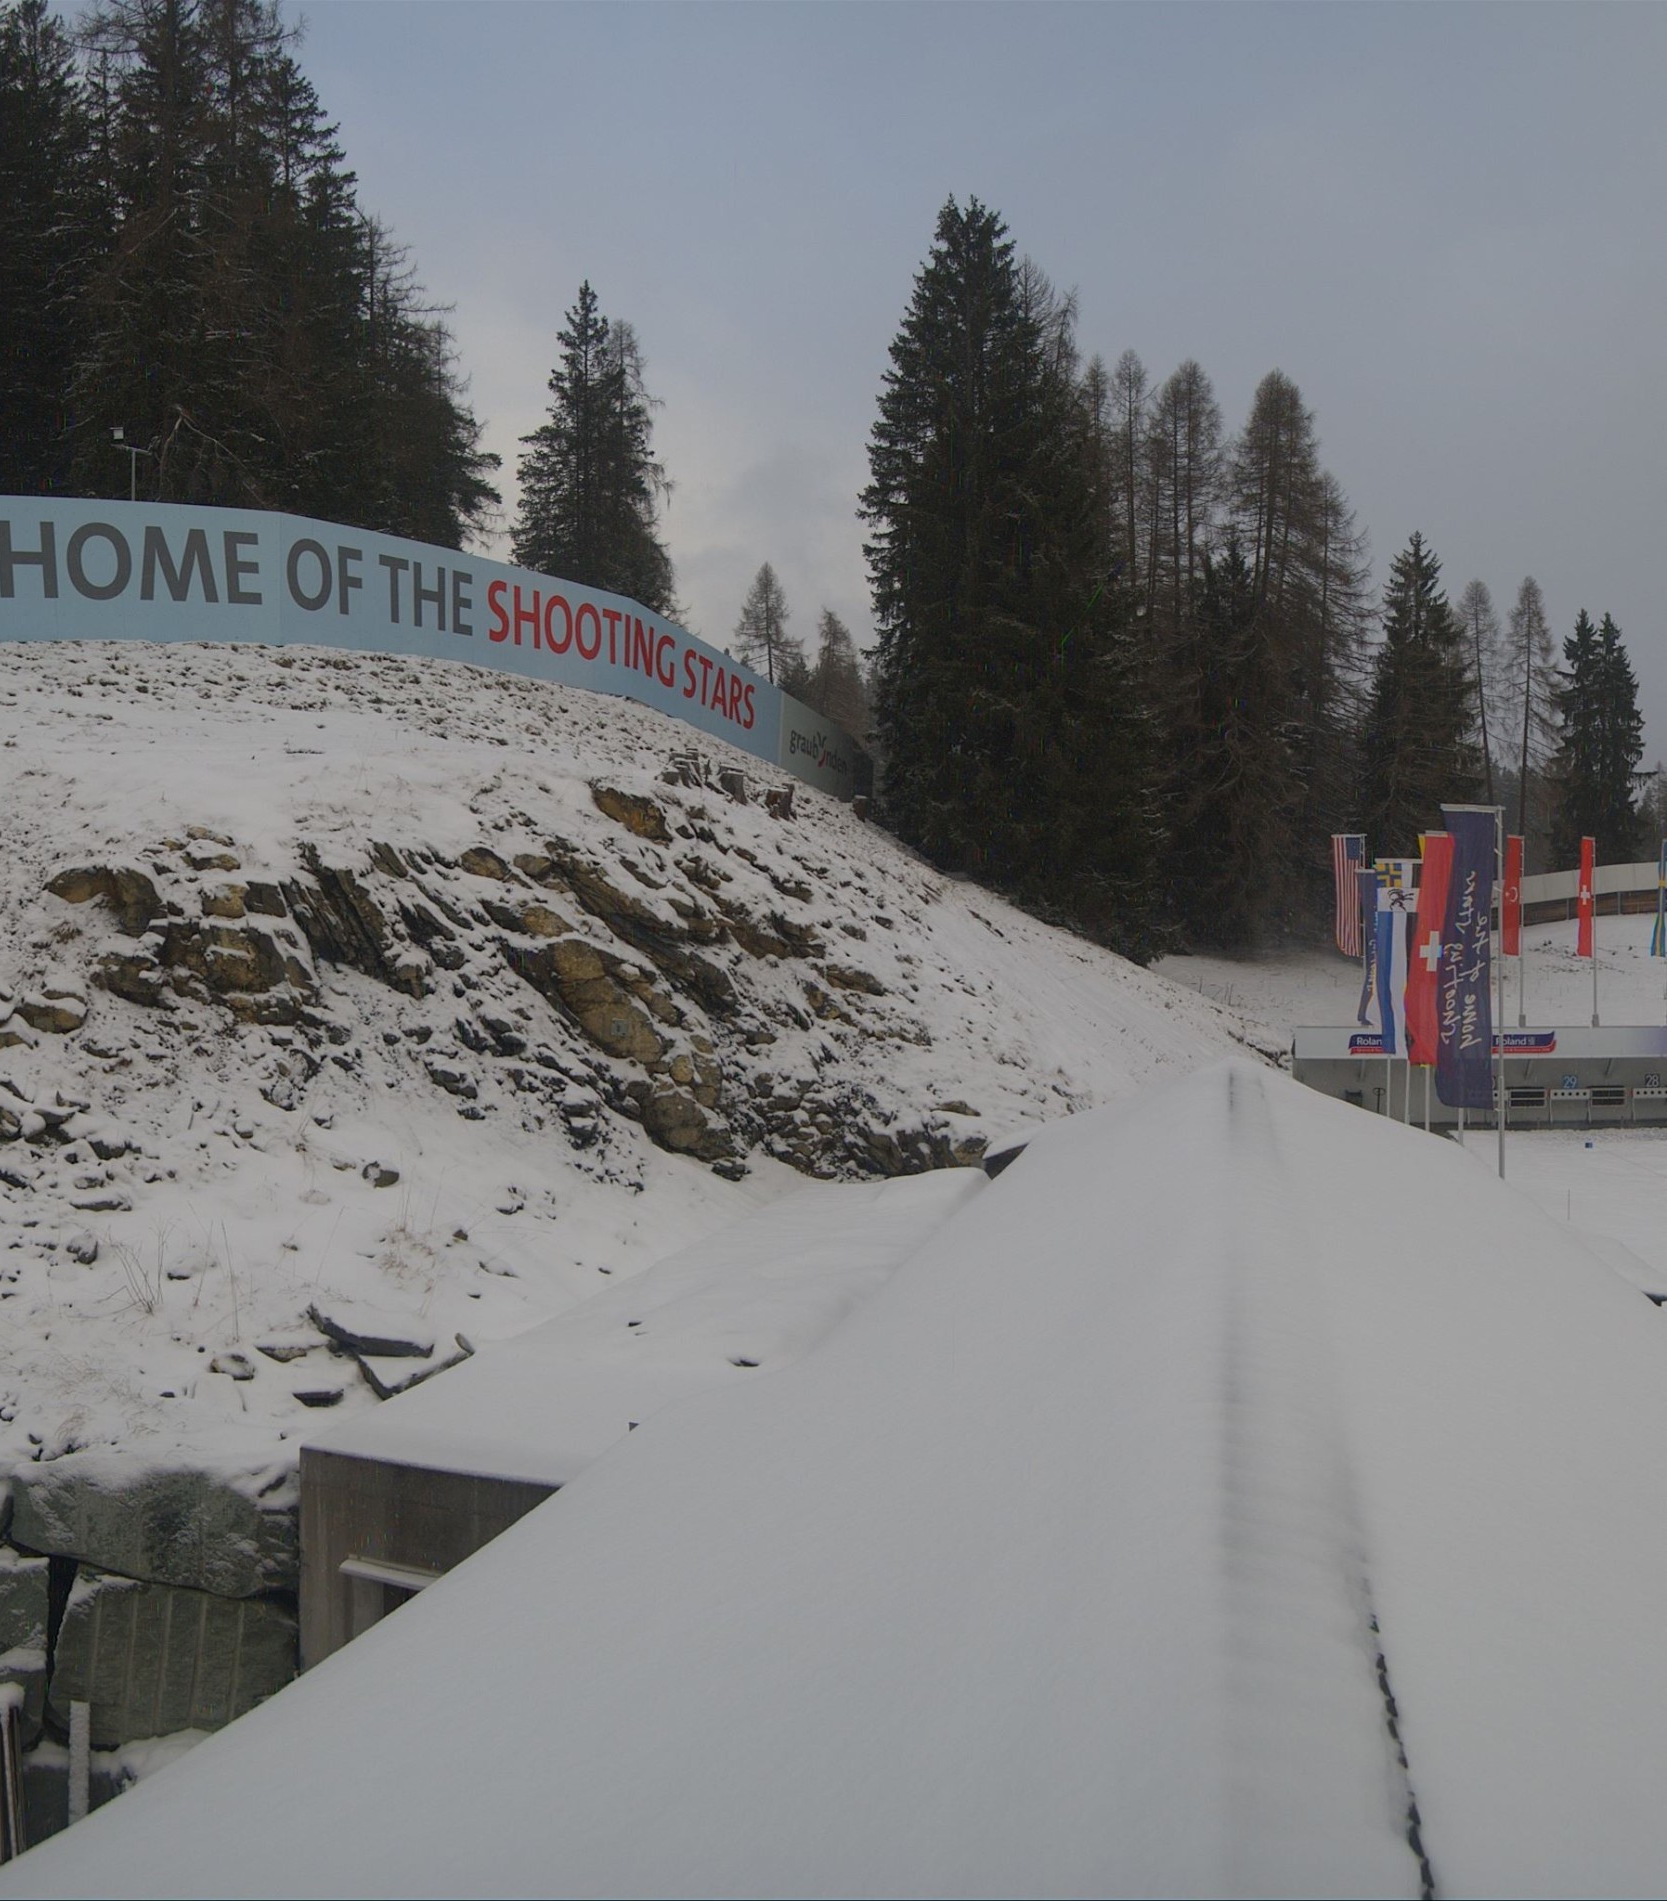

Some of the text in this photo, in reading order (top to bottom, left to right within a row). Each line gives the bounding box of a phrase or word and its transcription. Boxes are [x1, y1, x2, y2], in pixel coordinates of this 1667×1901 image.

[286, 537, 364, 615] OF
[378, 553, 473, 637] THE
[487, 579, 676, 688] SHOOTING
[682, 648, 757, 730] STARS
[1356, 1036, 1383, 1046] Rolan
[1563, 1076, 1576, 1089] 29
[1645, 1074, 1659, 1087] 28
